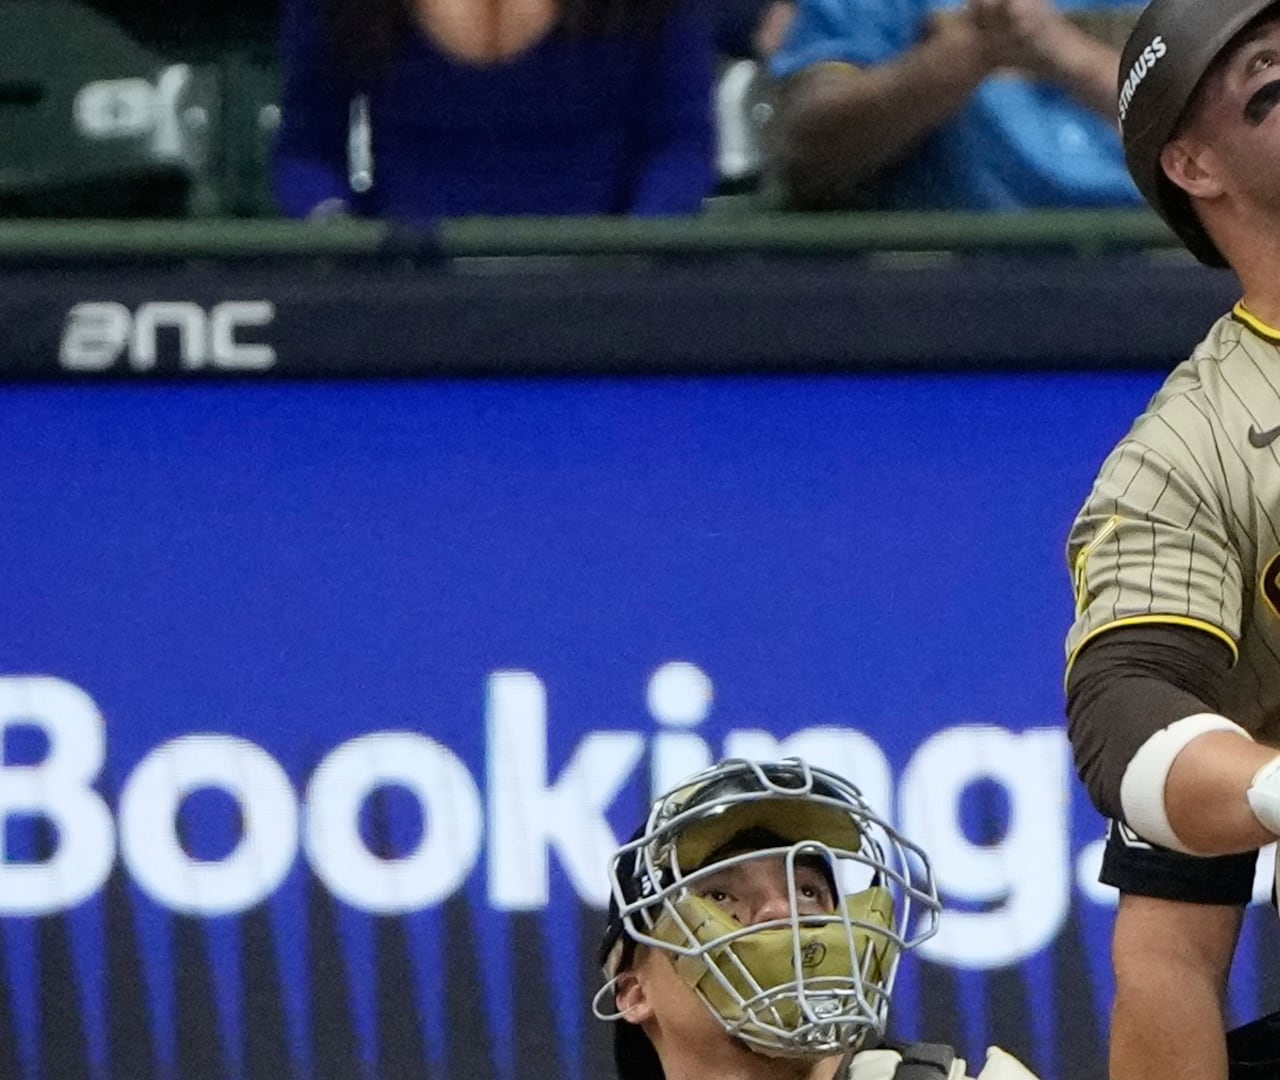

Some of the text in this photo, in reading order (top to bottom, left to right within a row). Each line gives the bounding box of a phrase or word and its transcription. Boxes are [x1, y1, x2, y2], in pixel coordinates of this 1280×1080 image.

[1118, 35, 1168, 120] STRAUSS
[59, 301, 277, 370] anc
[0, 661, 1277, 970] Booking.
